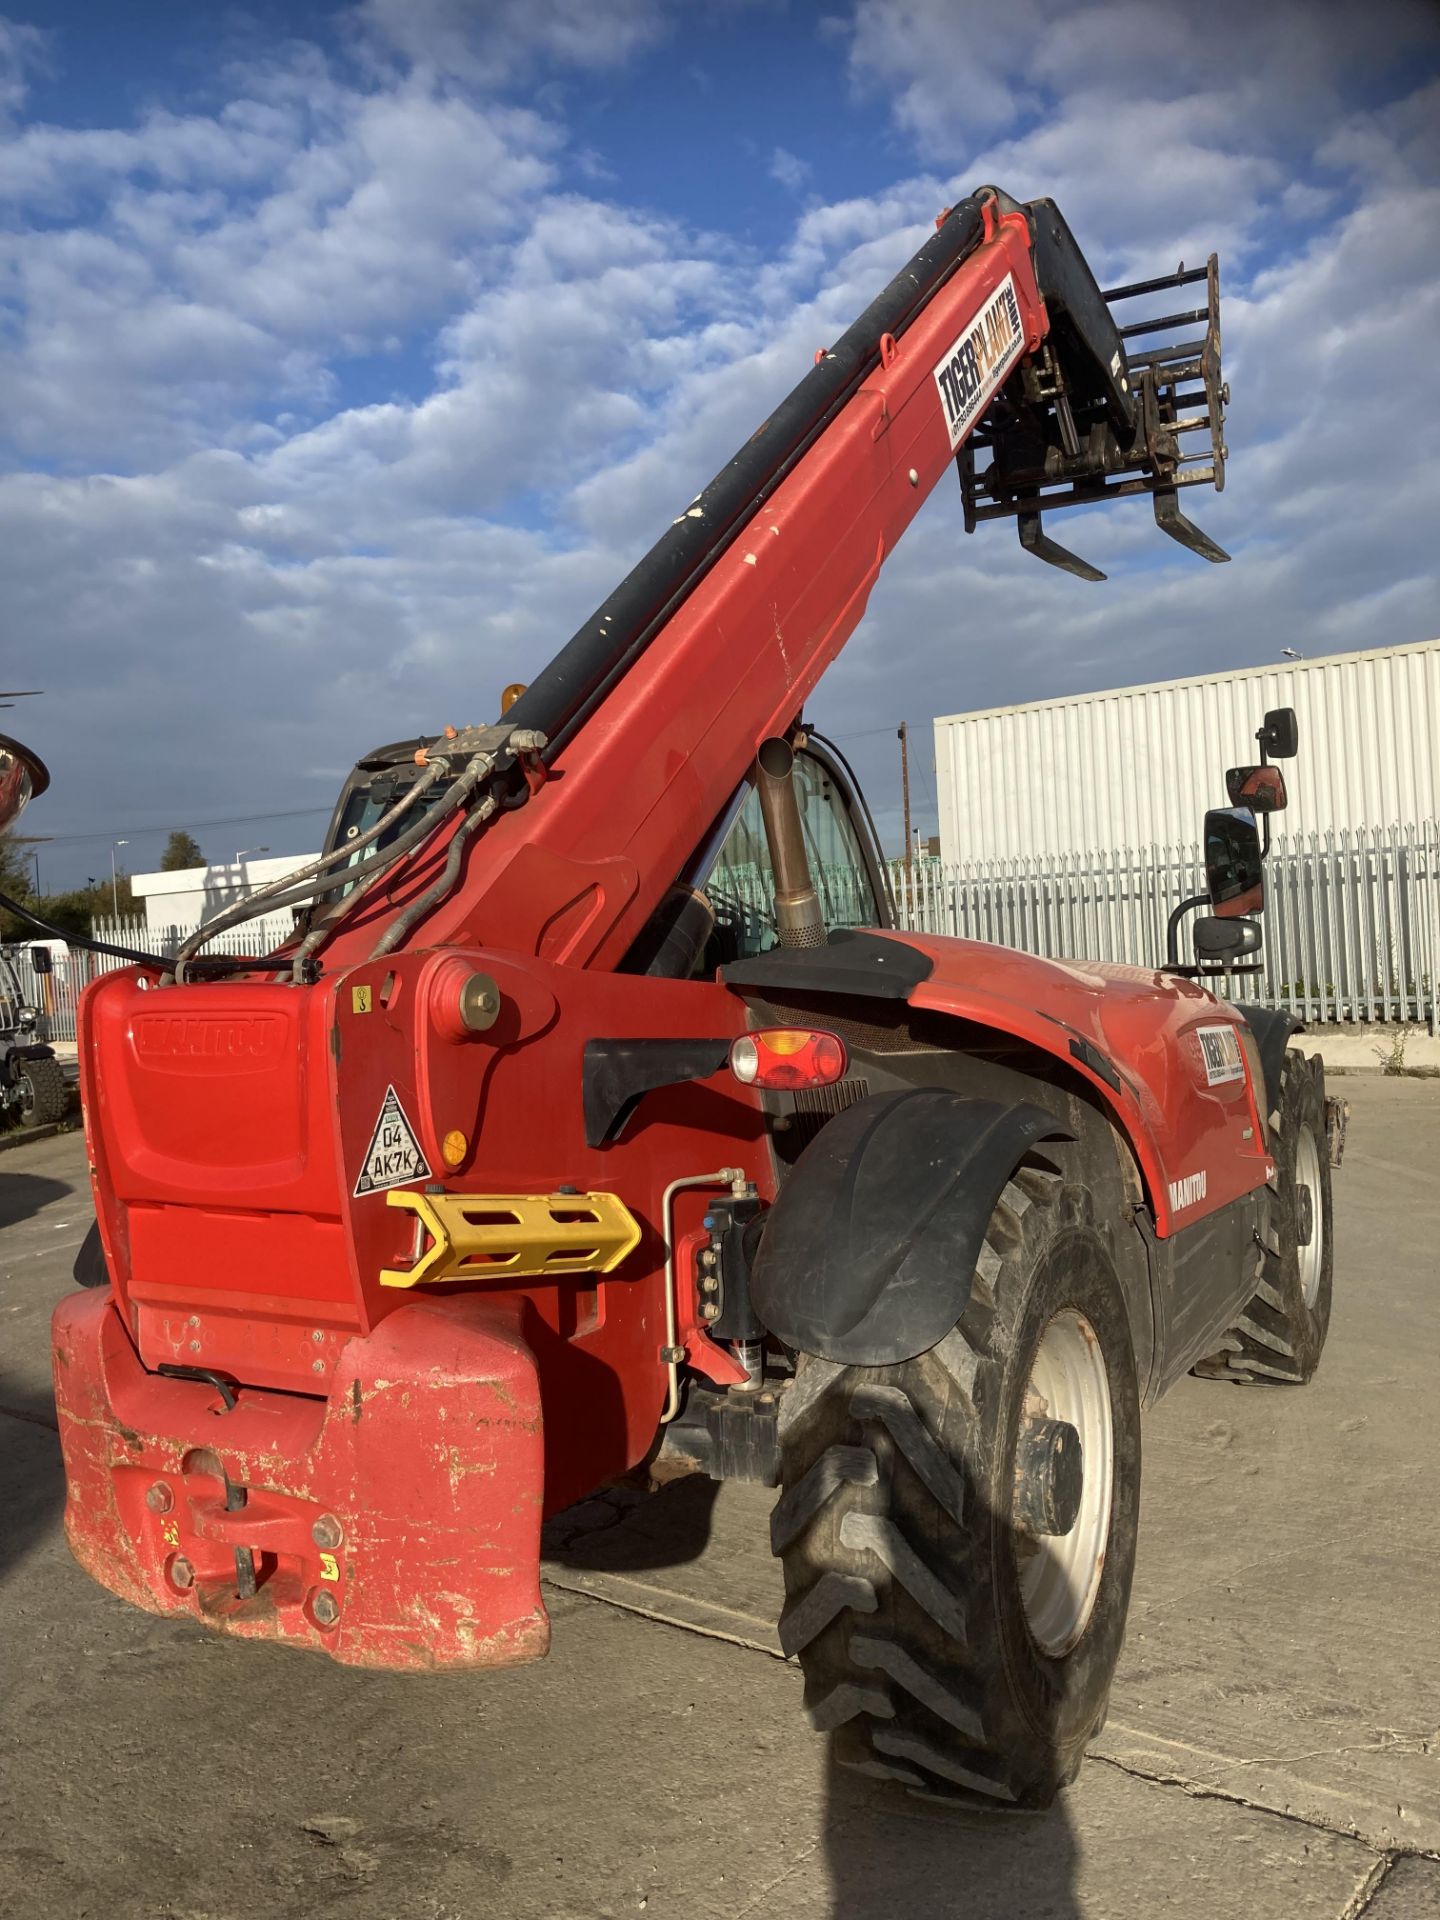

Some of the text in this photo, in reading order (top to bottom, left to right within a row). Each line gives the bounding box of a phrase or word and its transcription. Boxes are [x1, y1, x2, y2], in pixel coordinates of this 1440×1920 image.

[1005, 282, 1020, 335] HIRE
[138, 1016, 277, 1057] MANITOU
[373, 1149, 413, 1178] AK7K
[1168, 1170, 1207, 1212] MANITOU
